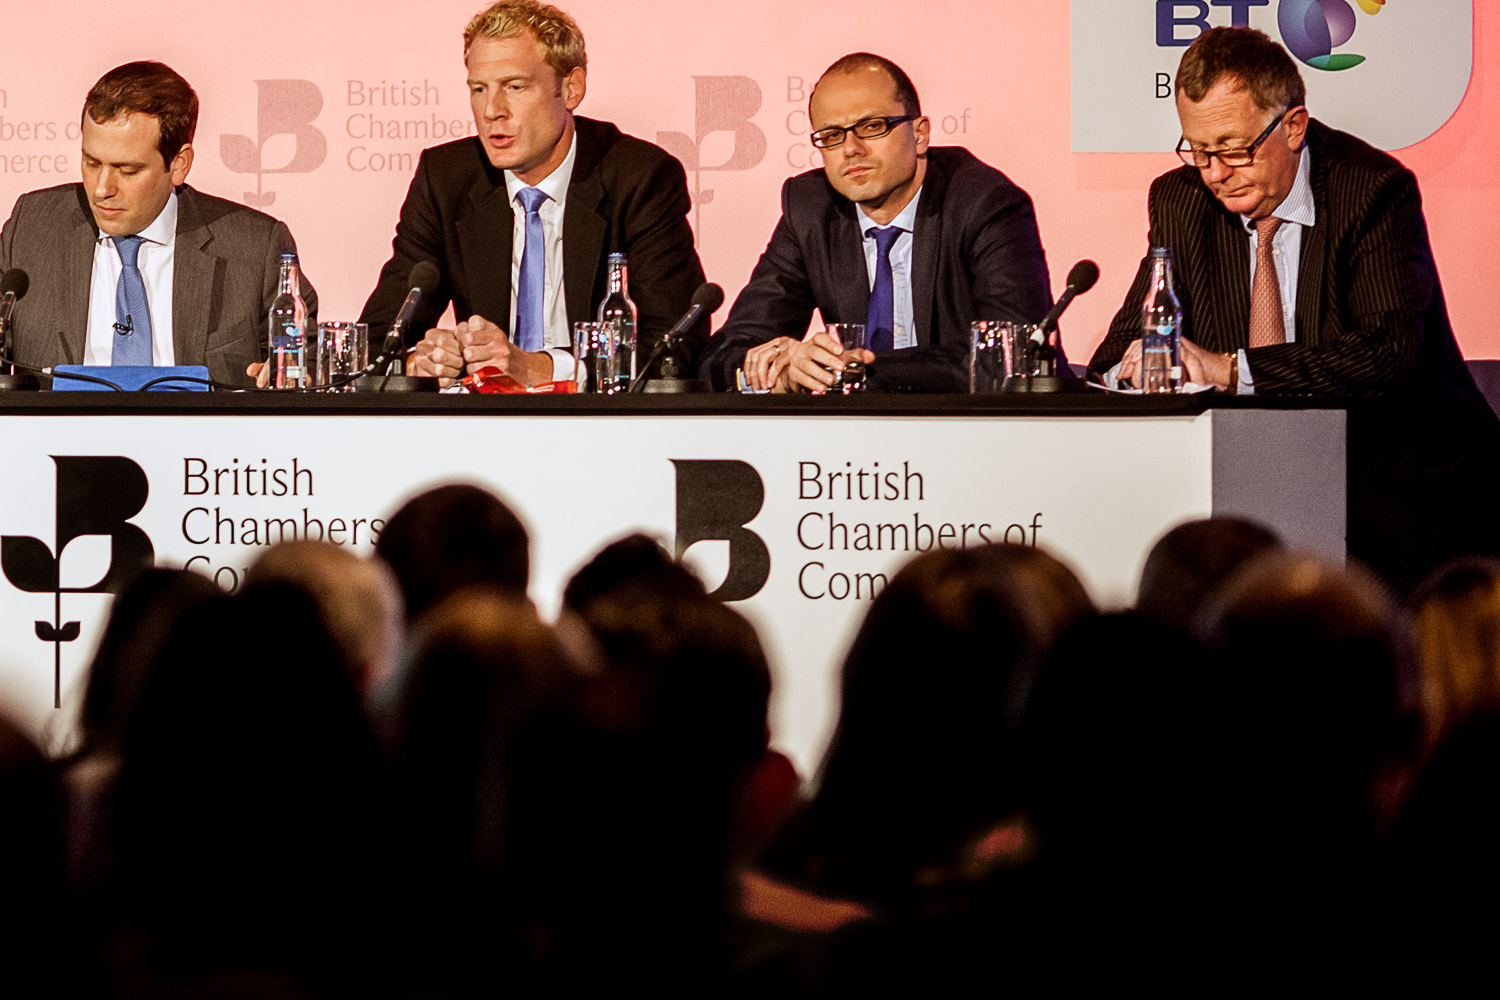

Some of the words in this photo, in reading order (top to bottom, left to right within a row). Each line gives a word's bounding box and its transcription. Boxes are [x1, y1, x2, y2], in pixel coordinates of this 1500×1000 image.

[347, 79, 439, 106] British
[65, 121, 82, 139] o
[346, 113, 476, 139] Chamber
[941, 107, 971, 135] of
[183, 457, 314, 497] British
[798, 461, 924, 501] British
[182, 507, 388, 546] Chambers
[797, 511, 994, 554] Chambers
[1004, 512, 1043, 549] of
